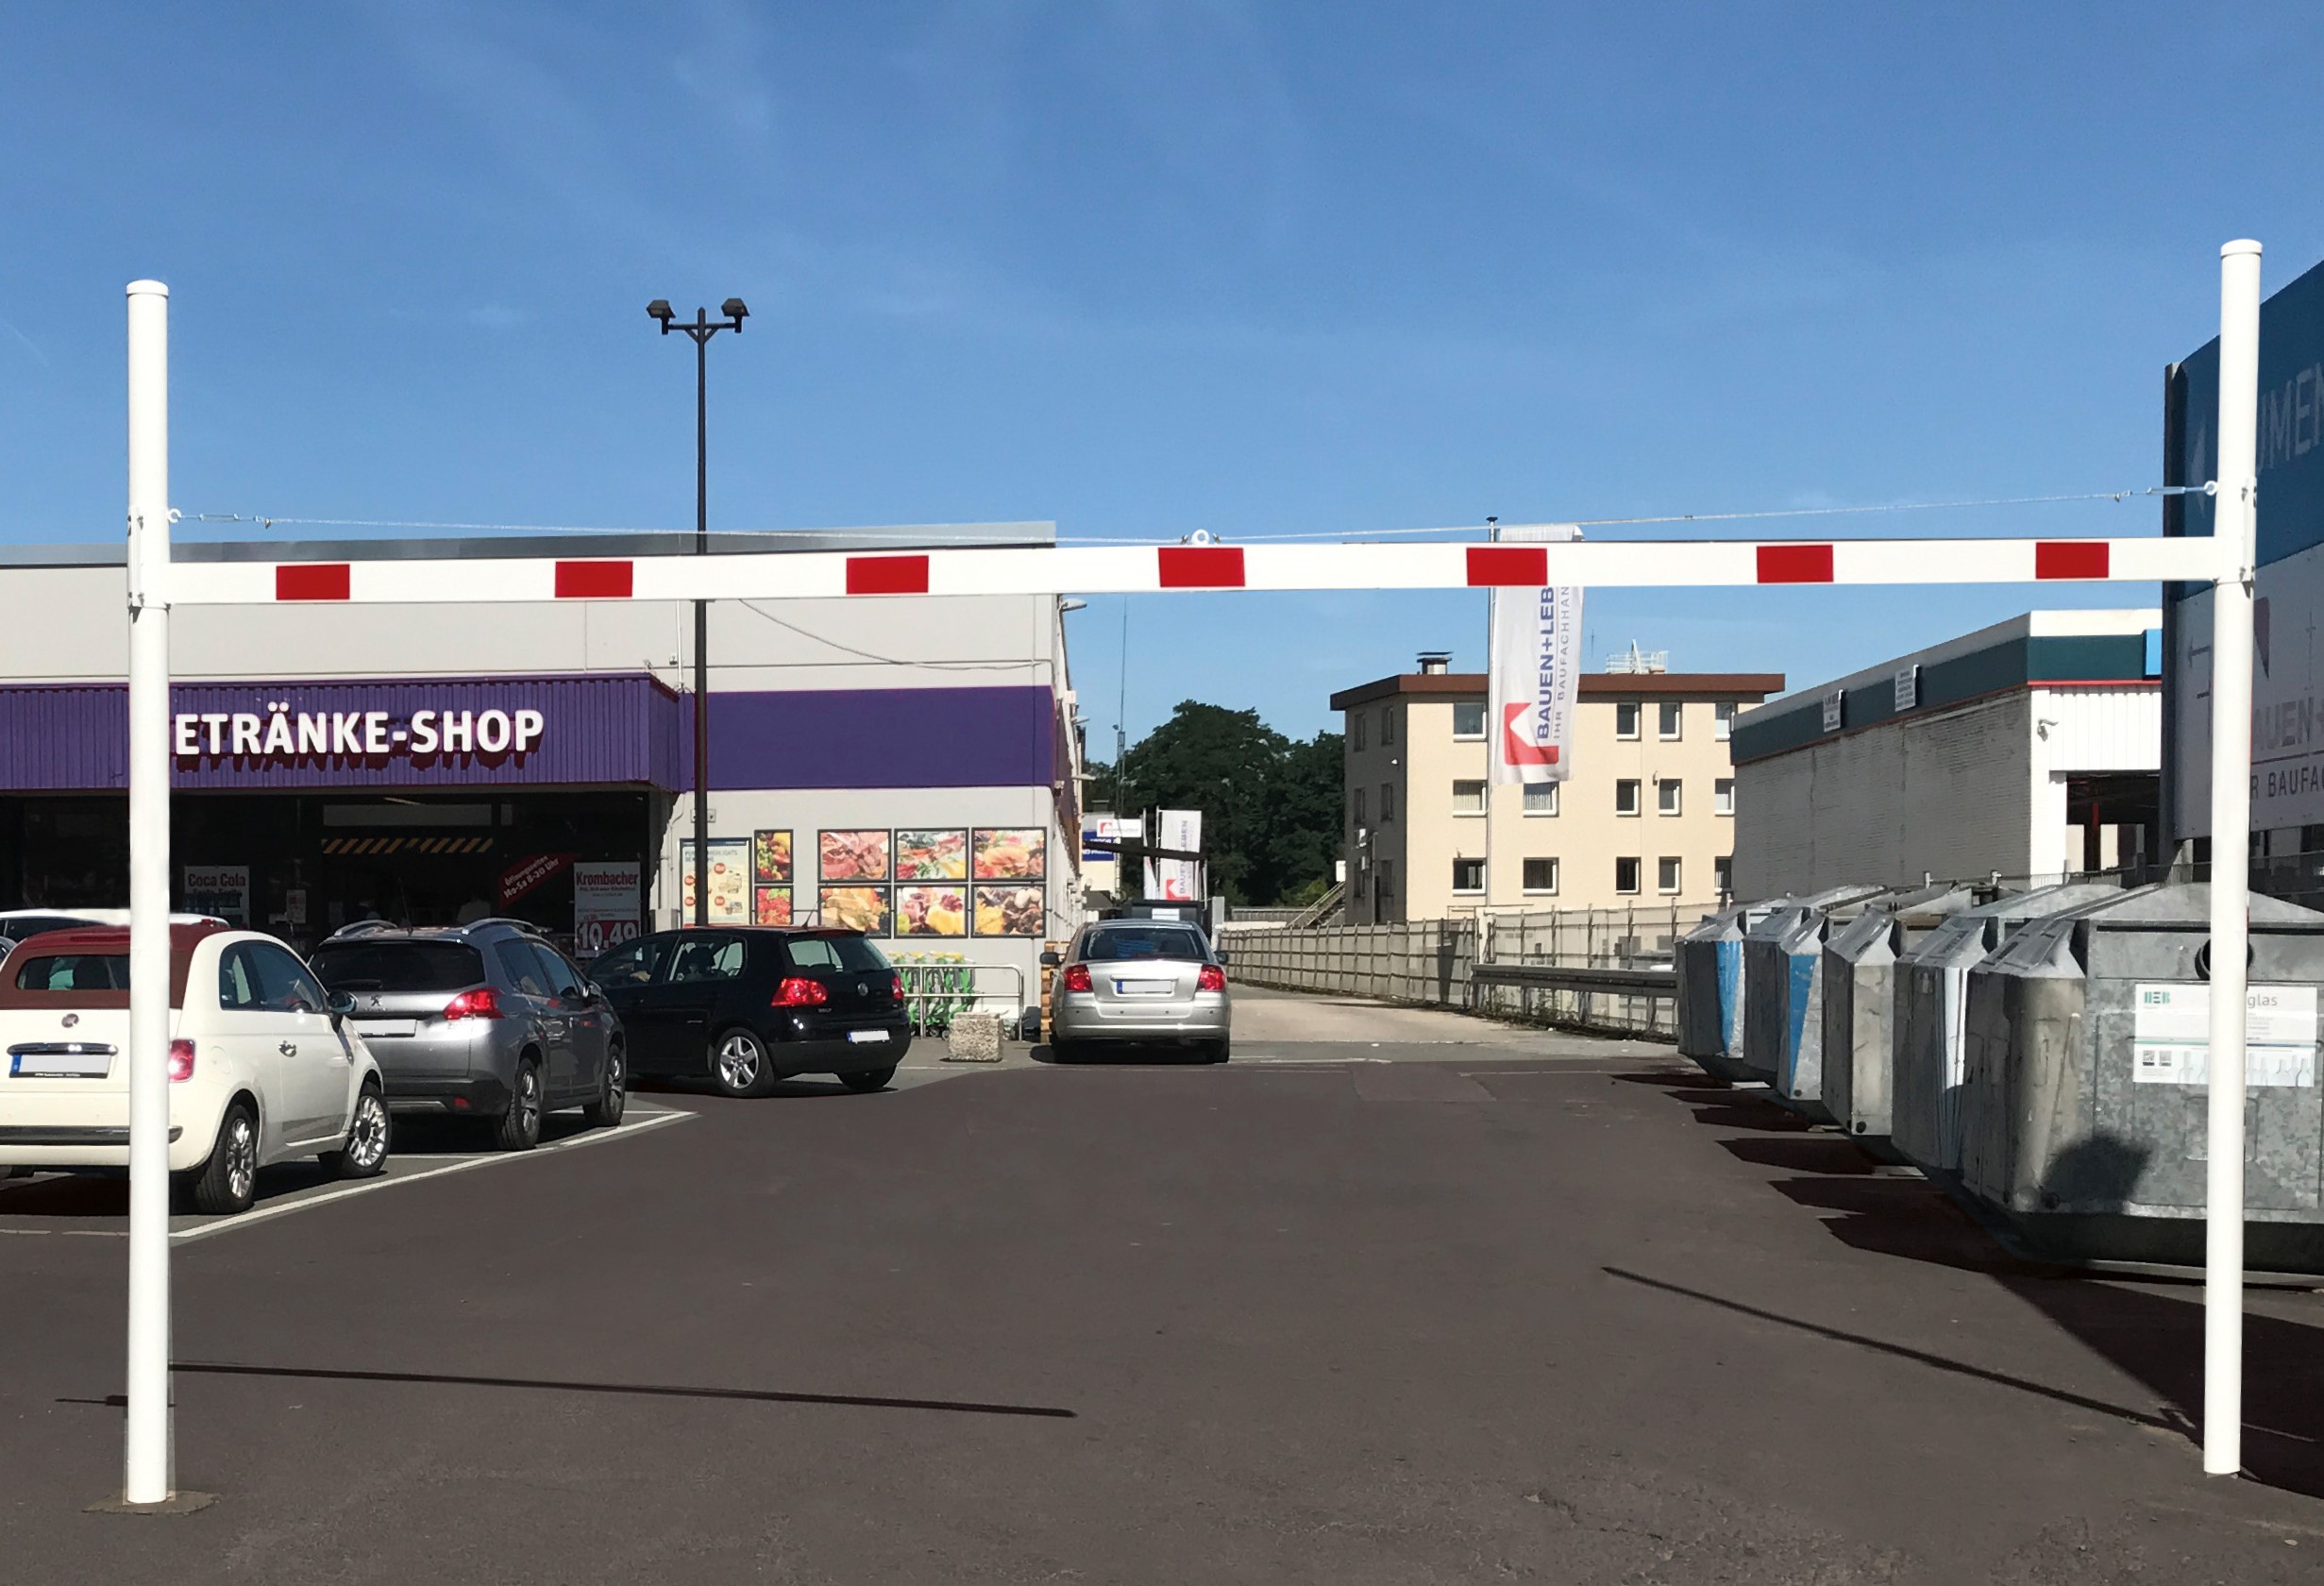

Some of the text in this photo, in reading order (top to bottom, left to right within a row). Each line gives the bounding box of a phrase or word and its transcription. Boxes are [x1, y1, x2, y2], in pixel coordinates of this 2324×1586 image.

[1537, 586, 1555, 739] BAUEN+LEB
[1553, 586, 1570, 739] IHR BAUFACHHAN
[175, 701, 544, 755] ETRÄNKE-SHOP
[2267, 764, 2324, 798] BAUFA
[189, 872, 245, 887] Coca Cola
[503, 880, 528, 899] Mo-Sa
[545, 857, 559, 870] Uhr
[576, 870, 639, 886] Krombacher
[579, 921, 638, 949] 10.49
[2247, 993, 2278, 1009] glas
